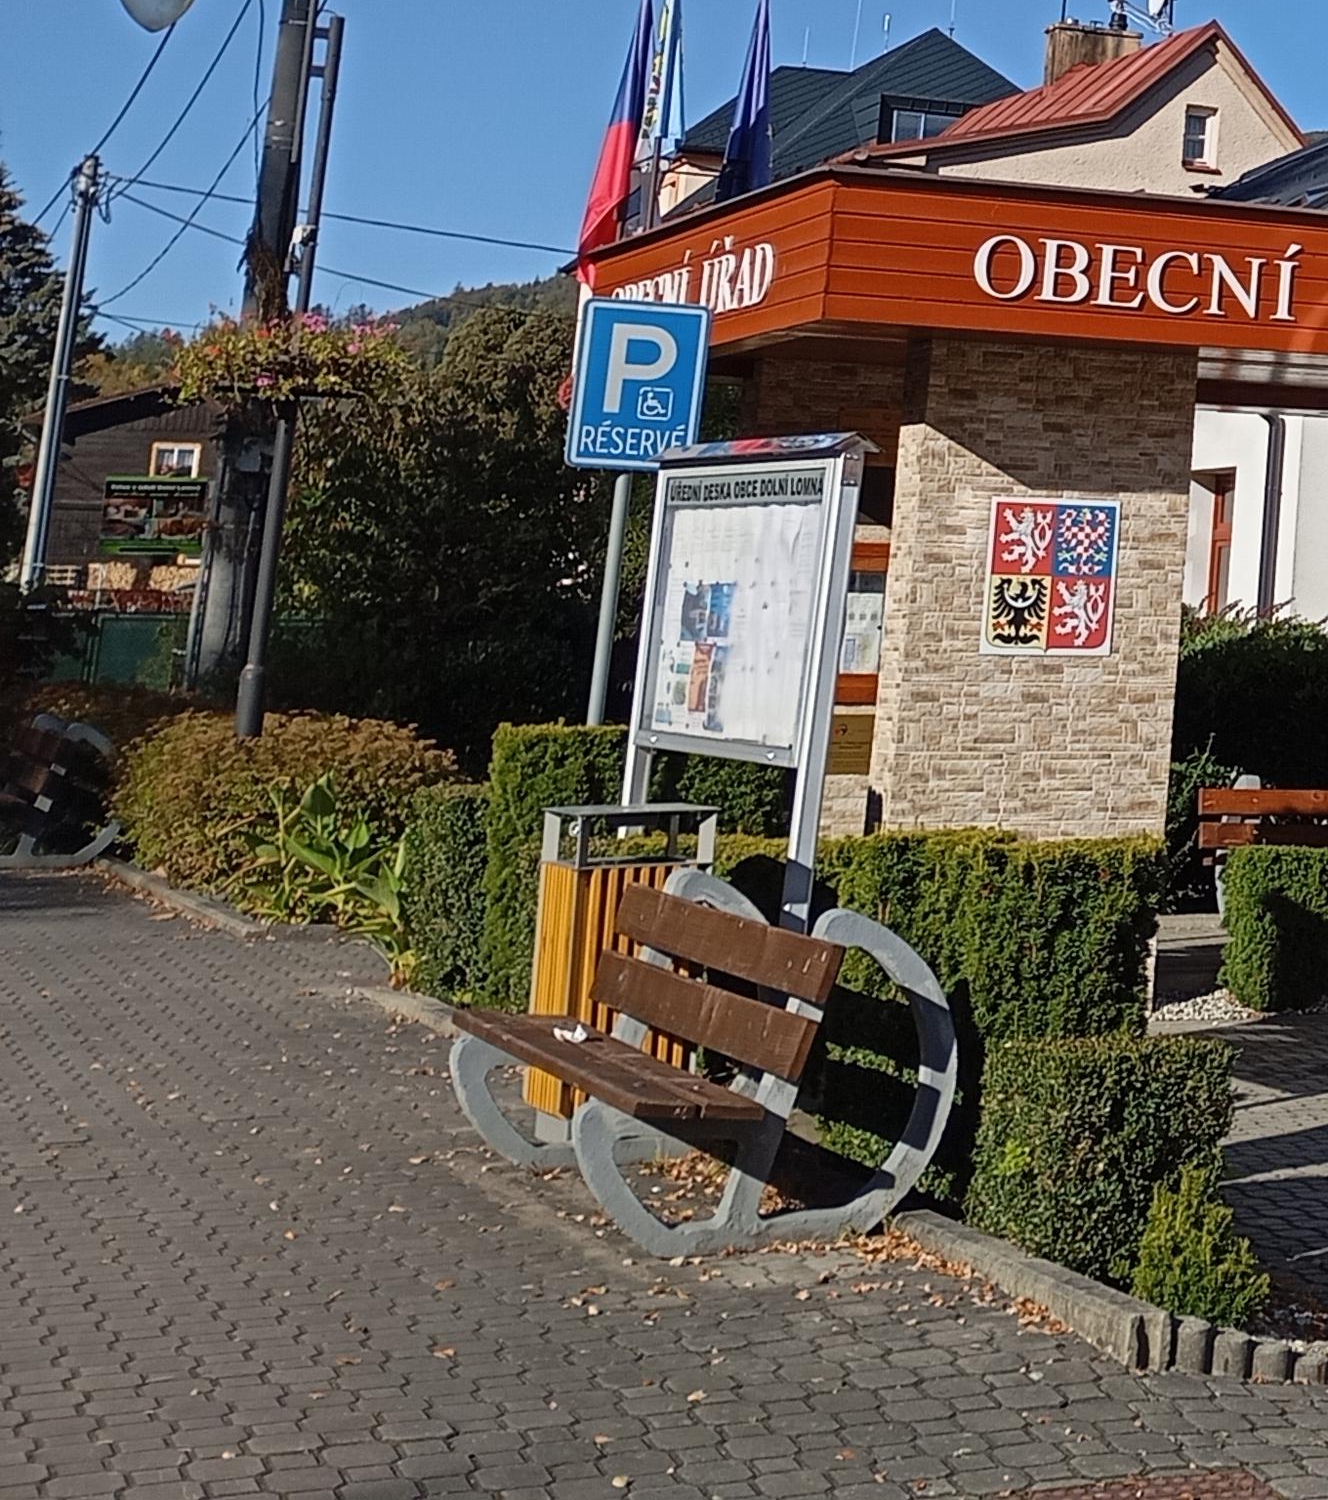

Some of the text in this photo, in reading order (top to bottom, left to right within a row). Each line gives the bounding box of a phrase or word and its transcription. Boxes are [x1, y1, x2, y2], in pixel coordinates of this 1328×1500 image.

[700, 235, 775, 314] ÚŘAD
[973, 234, 1303, 321] OBECNÍ
[602, 322, 678, 414] P
[579, 419, 685, 456] RÉSERVÉ
[703, 481, 731, 502] DESKA
[733, 479, 758, 499] OBCE
[760, 473, 788, 497] DOLNÍ
